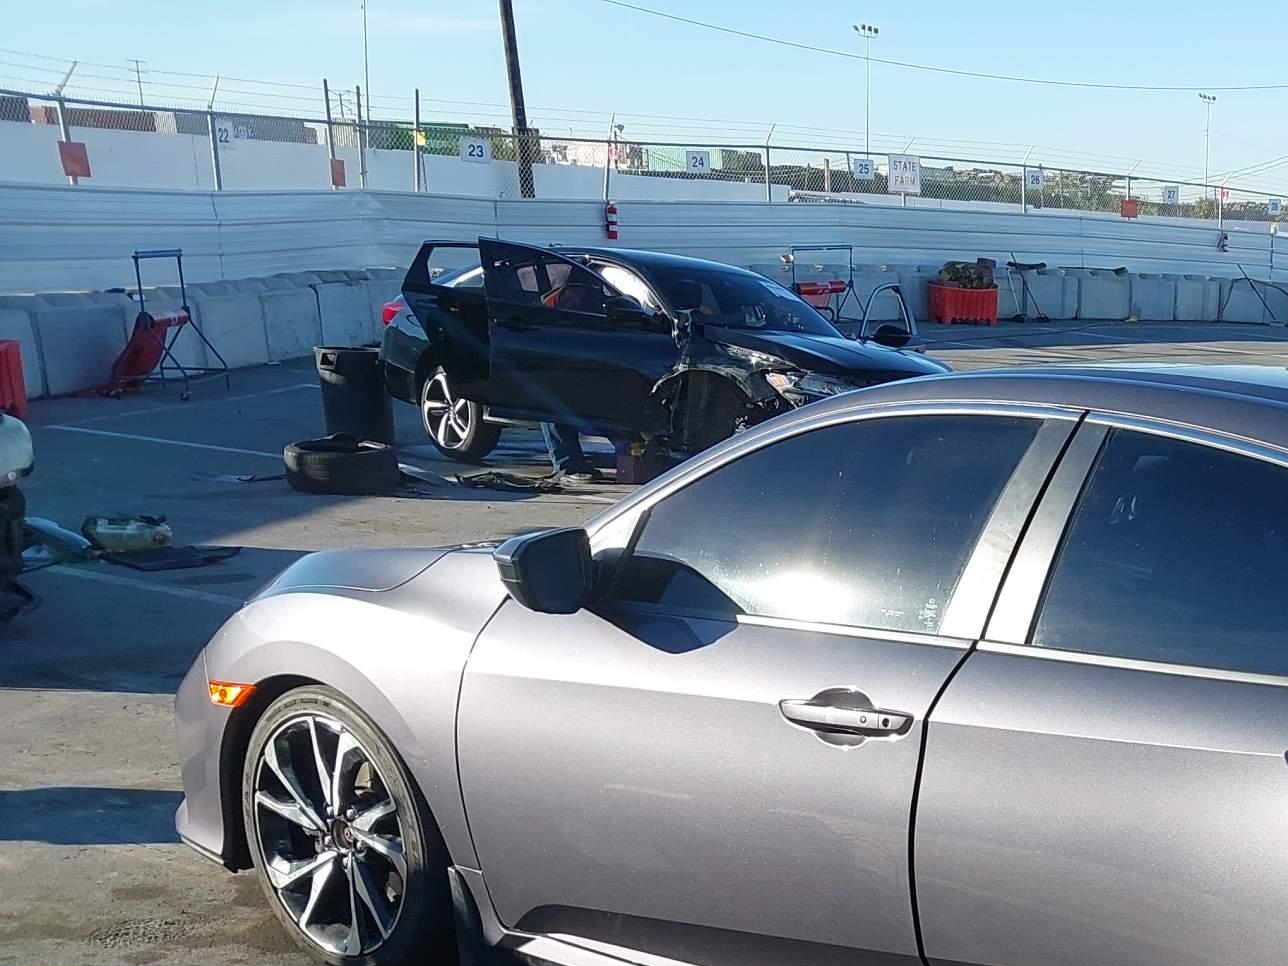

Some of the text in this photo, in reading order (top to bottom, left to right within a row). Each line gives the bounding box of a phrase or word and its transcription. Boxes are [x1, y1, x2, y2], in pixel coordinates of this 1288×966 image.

[218, 127, 229, 143] 22
[468, 143, 484, 158] 23
[692, 155, 705, 168] 24
[893, 160, 917, 172] STATE
[858, 163, 870, 175] 25
[894, 175, 916, 187] FARM
[1030, 174, 1041, 185] 26
[1167, 190, 1176, 199] 27
